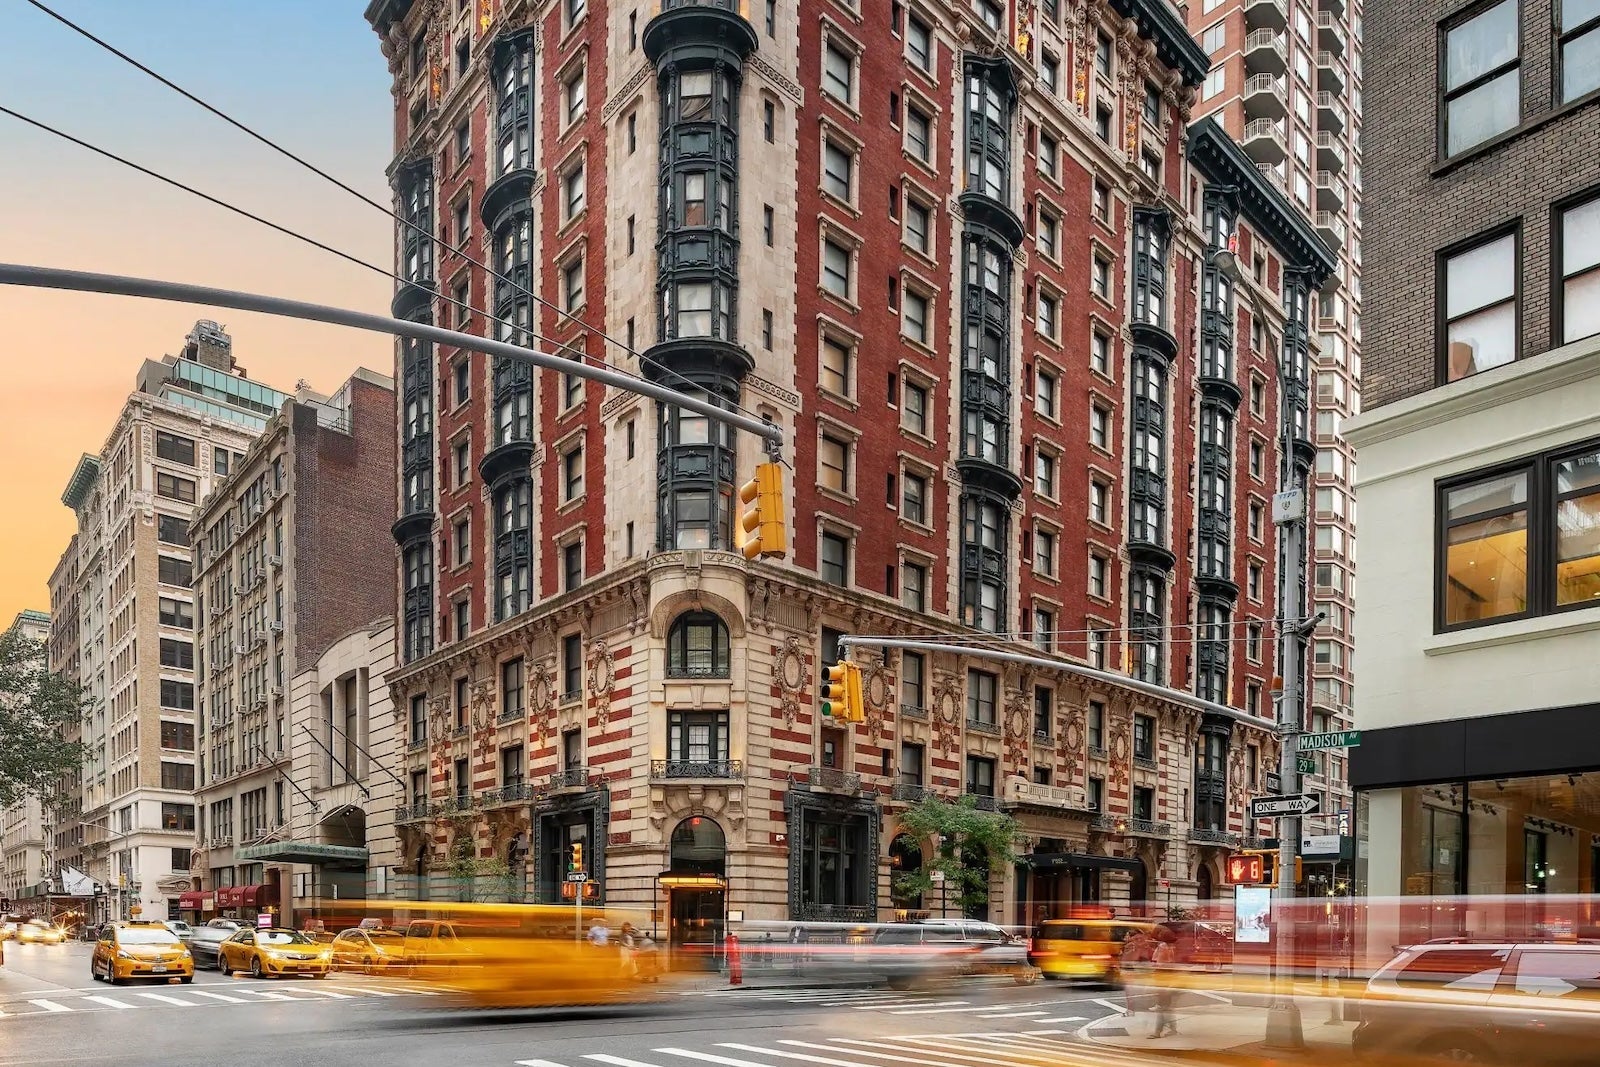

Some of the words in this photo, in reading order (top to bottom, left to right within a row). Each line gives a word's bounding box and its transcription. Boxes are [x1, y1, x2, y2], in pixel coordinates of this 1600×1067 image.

[1300, 733, 1345, 749] MADISON
[1299, 760, 1308, 772] 29
[1257, 803, 1277, 812] ONE
[1288, 800, 1310, 810] WAY
[1250, 861, 1259, 879] 6
